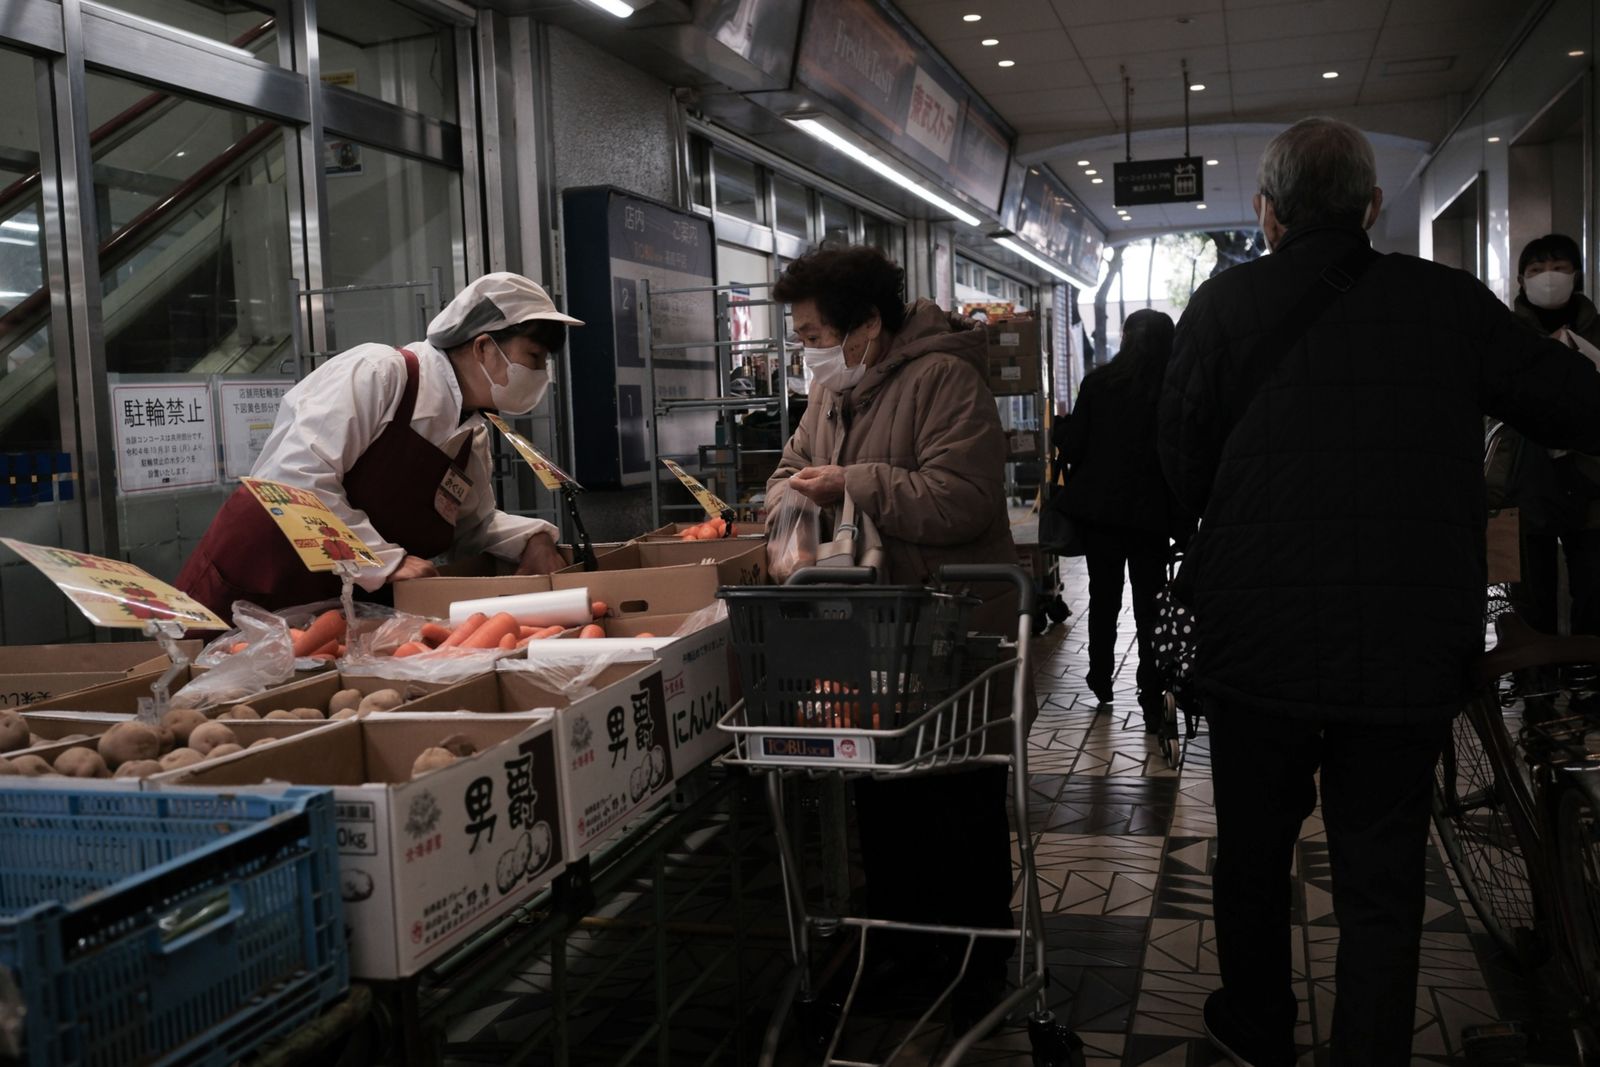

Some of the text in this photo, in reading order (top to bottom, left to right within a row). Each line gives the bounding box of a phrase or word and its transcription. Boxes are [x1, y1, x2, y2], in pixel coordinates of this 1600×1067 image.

[910, 84, 955, 145] 東武ストア
[624, 205, 645, 233] 店内
[621, 288, 629, 311] 2
[124, 398, 205, 428] 駐輪禁止
[606, 689, 656, 768] 男爵
[672, 685, 728, 749] にんじん
[767, 738, 807, 755] TOBU
[463, 751, 539, 854] 男爵
